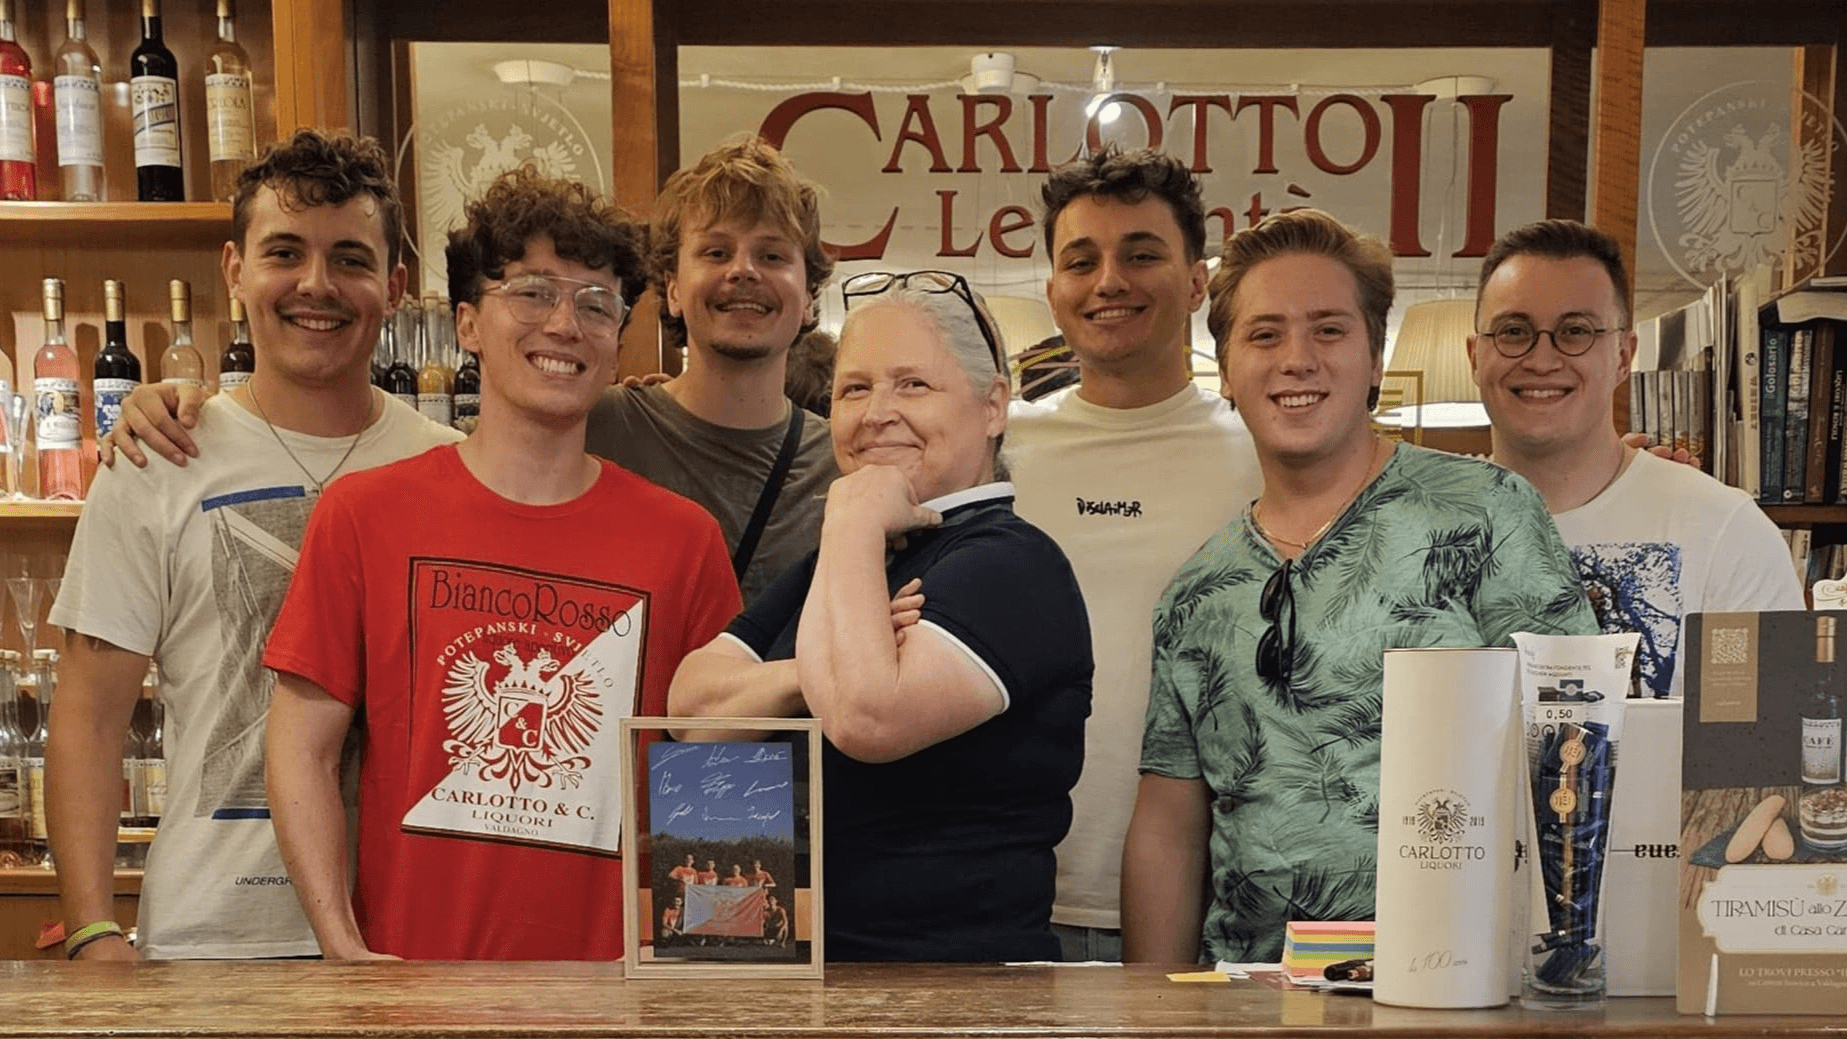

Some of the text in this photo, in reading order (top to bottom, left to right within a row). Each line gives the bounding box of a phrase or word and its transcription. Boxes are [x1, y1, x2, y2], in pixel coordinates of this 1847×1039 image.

[936, 190, 1036, 258] Le
[436, 622, 537, 667] POTEPANSKI
[522, 729, 538, 747] C
[431, 787, 595, 820] CARLOTTO & C.
[472, 810, 553, 828] LIQUORI
[484, 823, 539, 837] VALDAGNO
[1399, 845, 1485, 860] CARLOTTO
[1420, 861, 1462, 870] LIQUORI
[1711, 897, 1804, 918] TIRAMISÙ
[1808, 903, 1832, 915] allo
[1790, 925, 1822, 936] Casa
[1758, 968, 1792, 977] TROVI
[1794, 968, 1835, 977] PRESSO
